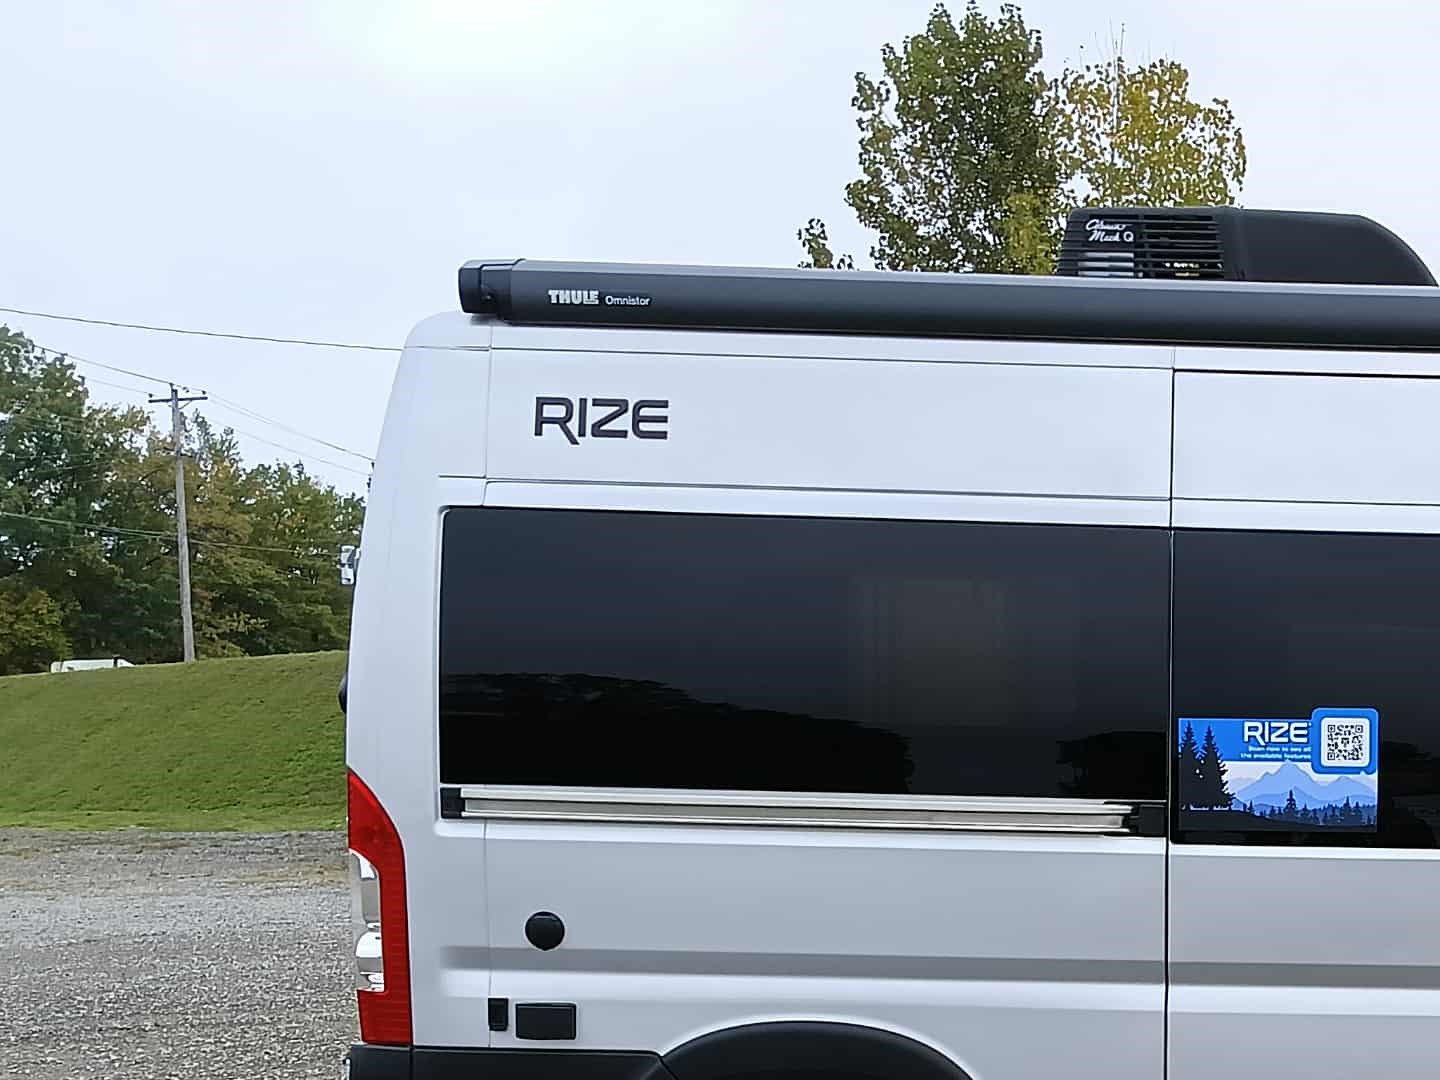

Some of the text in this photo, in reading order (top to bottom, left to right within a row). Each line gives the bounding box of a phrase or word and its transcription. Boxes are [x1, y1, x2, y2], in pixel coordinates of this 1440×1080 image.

[1123, 231, 1134, 242] Q
[548, 289, 651, 306] THULE Omnistor
[534, 396, 669, 445] RIZE
[1244, 722, 1308, 745] RIZE
